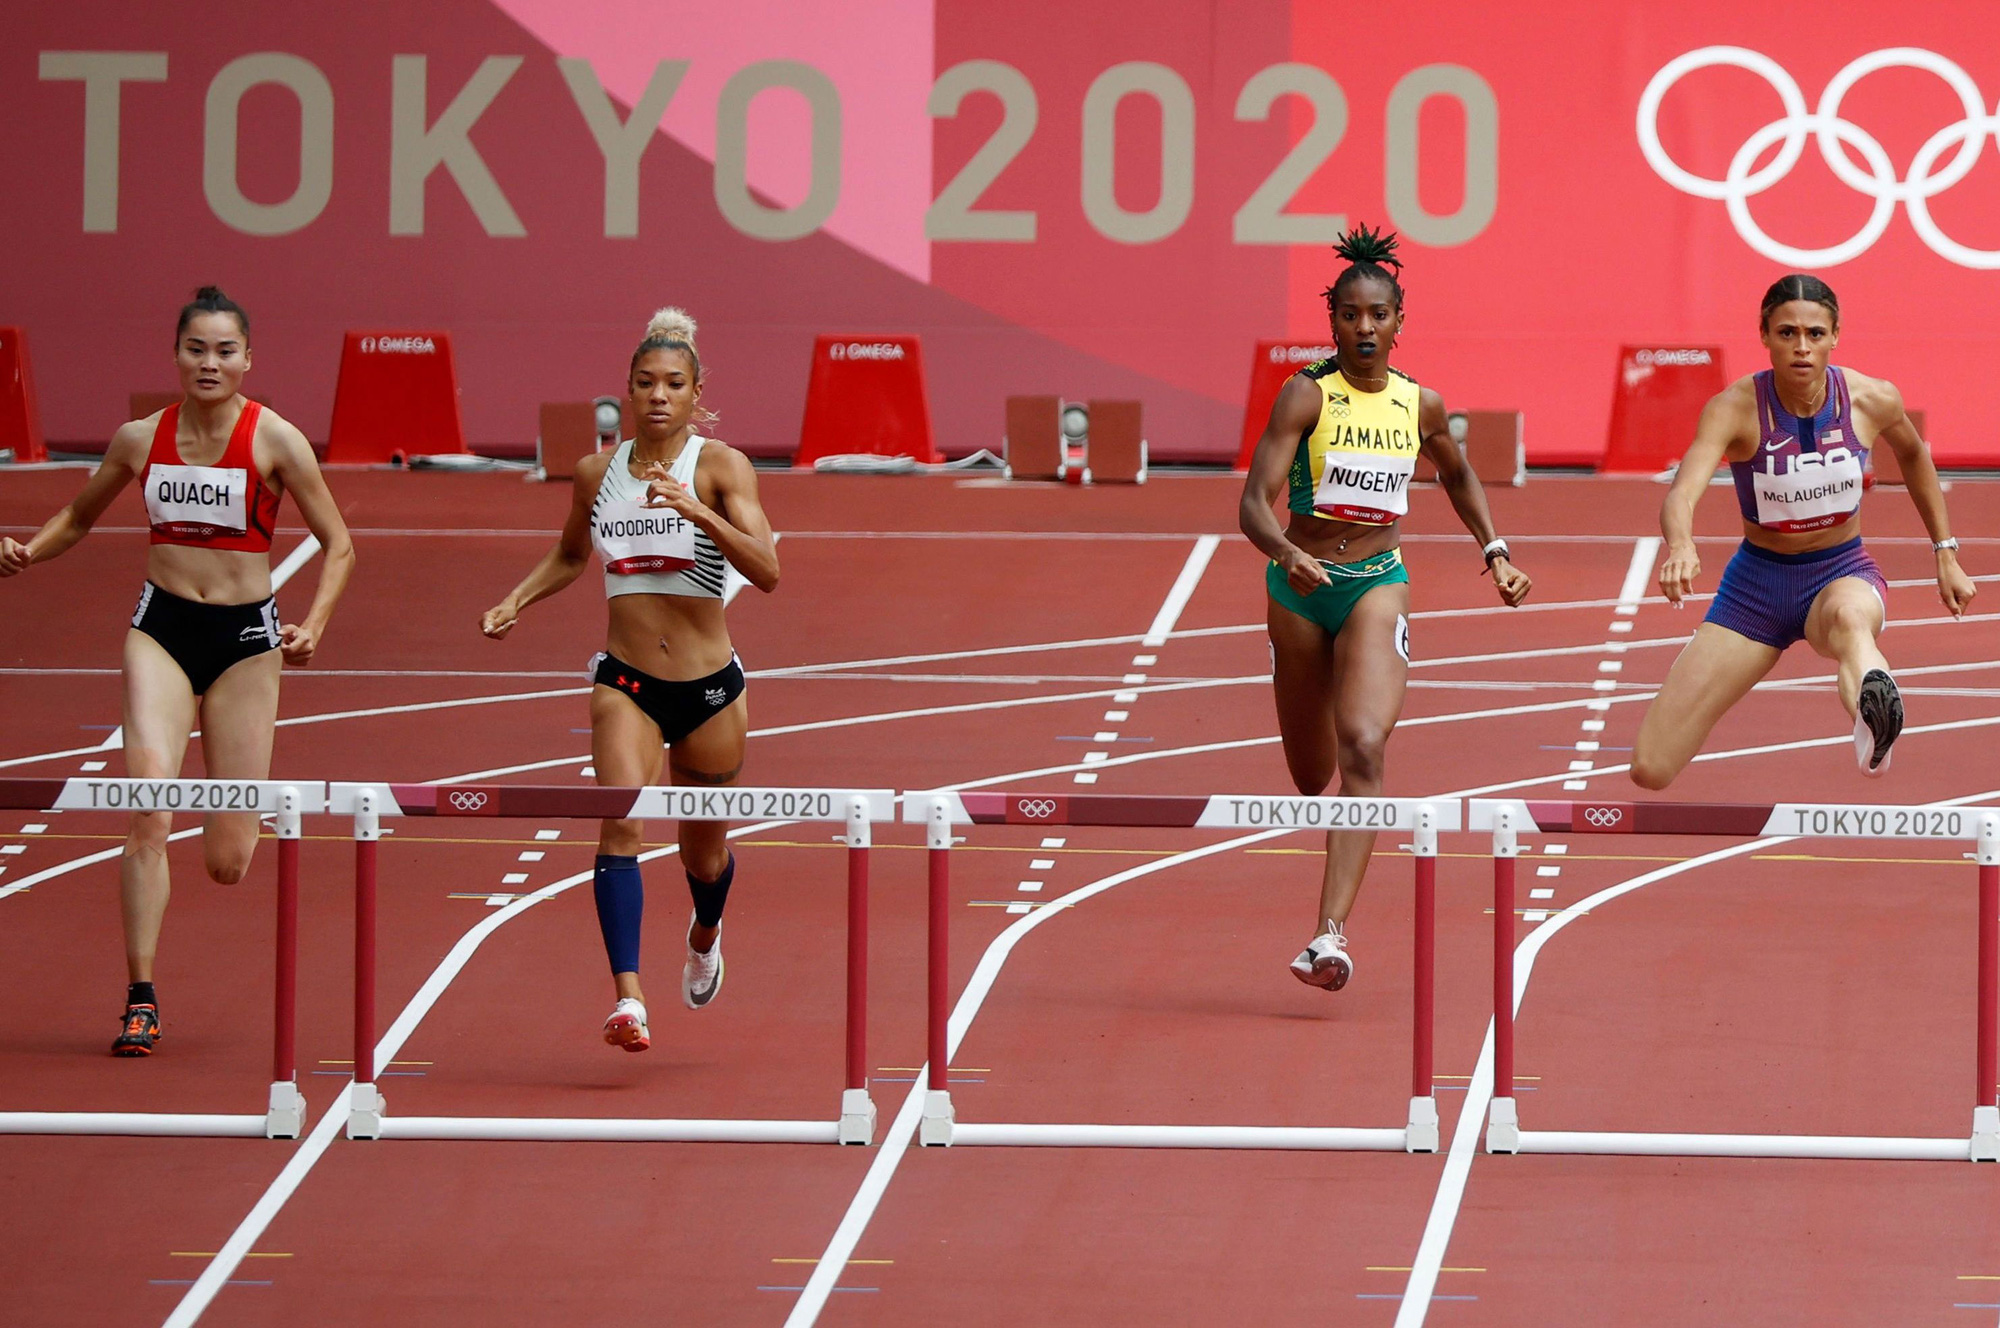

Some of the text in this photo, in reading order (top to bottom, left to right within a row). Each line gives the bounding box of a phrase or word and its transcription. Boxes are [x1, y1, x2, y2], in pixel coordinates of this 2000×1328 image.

[38, 50, 1500, 248] TOKYO 2020
[378, 336, 435, 354] OMEGA
[846, 343, 904, 360] OMEGA
[1652, 349, 1711, 366] OMEGA
[1329, 424, 1414, 451] JAMAICA
[1766, 447, 1853, 476] USA
[1328, 466, 1409, 493] NUGENT
[1763, 479, 1854, 504] McLAUGHLIN
[158, 480, 230, 507] QUACH
[600, 517, 686, 538] WOODRUFF
[88, 783, 260, 809] TOKYO 2020
[661, 791, 831, 818] TOKYO 2020
[1230, 800, 1397, 827] TOKYO 2020
[1794, 809, 1962, 837] TOKYO 2020
